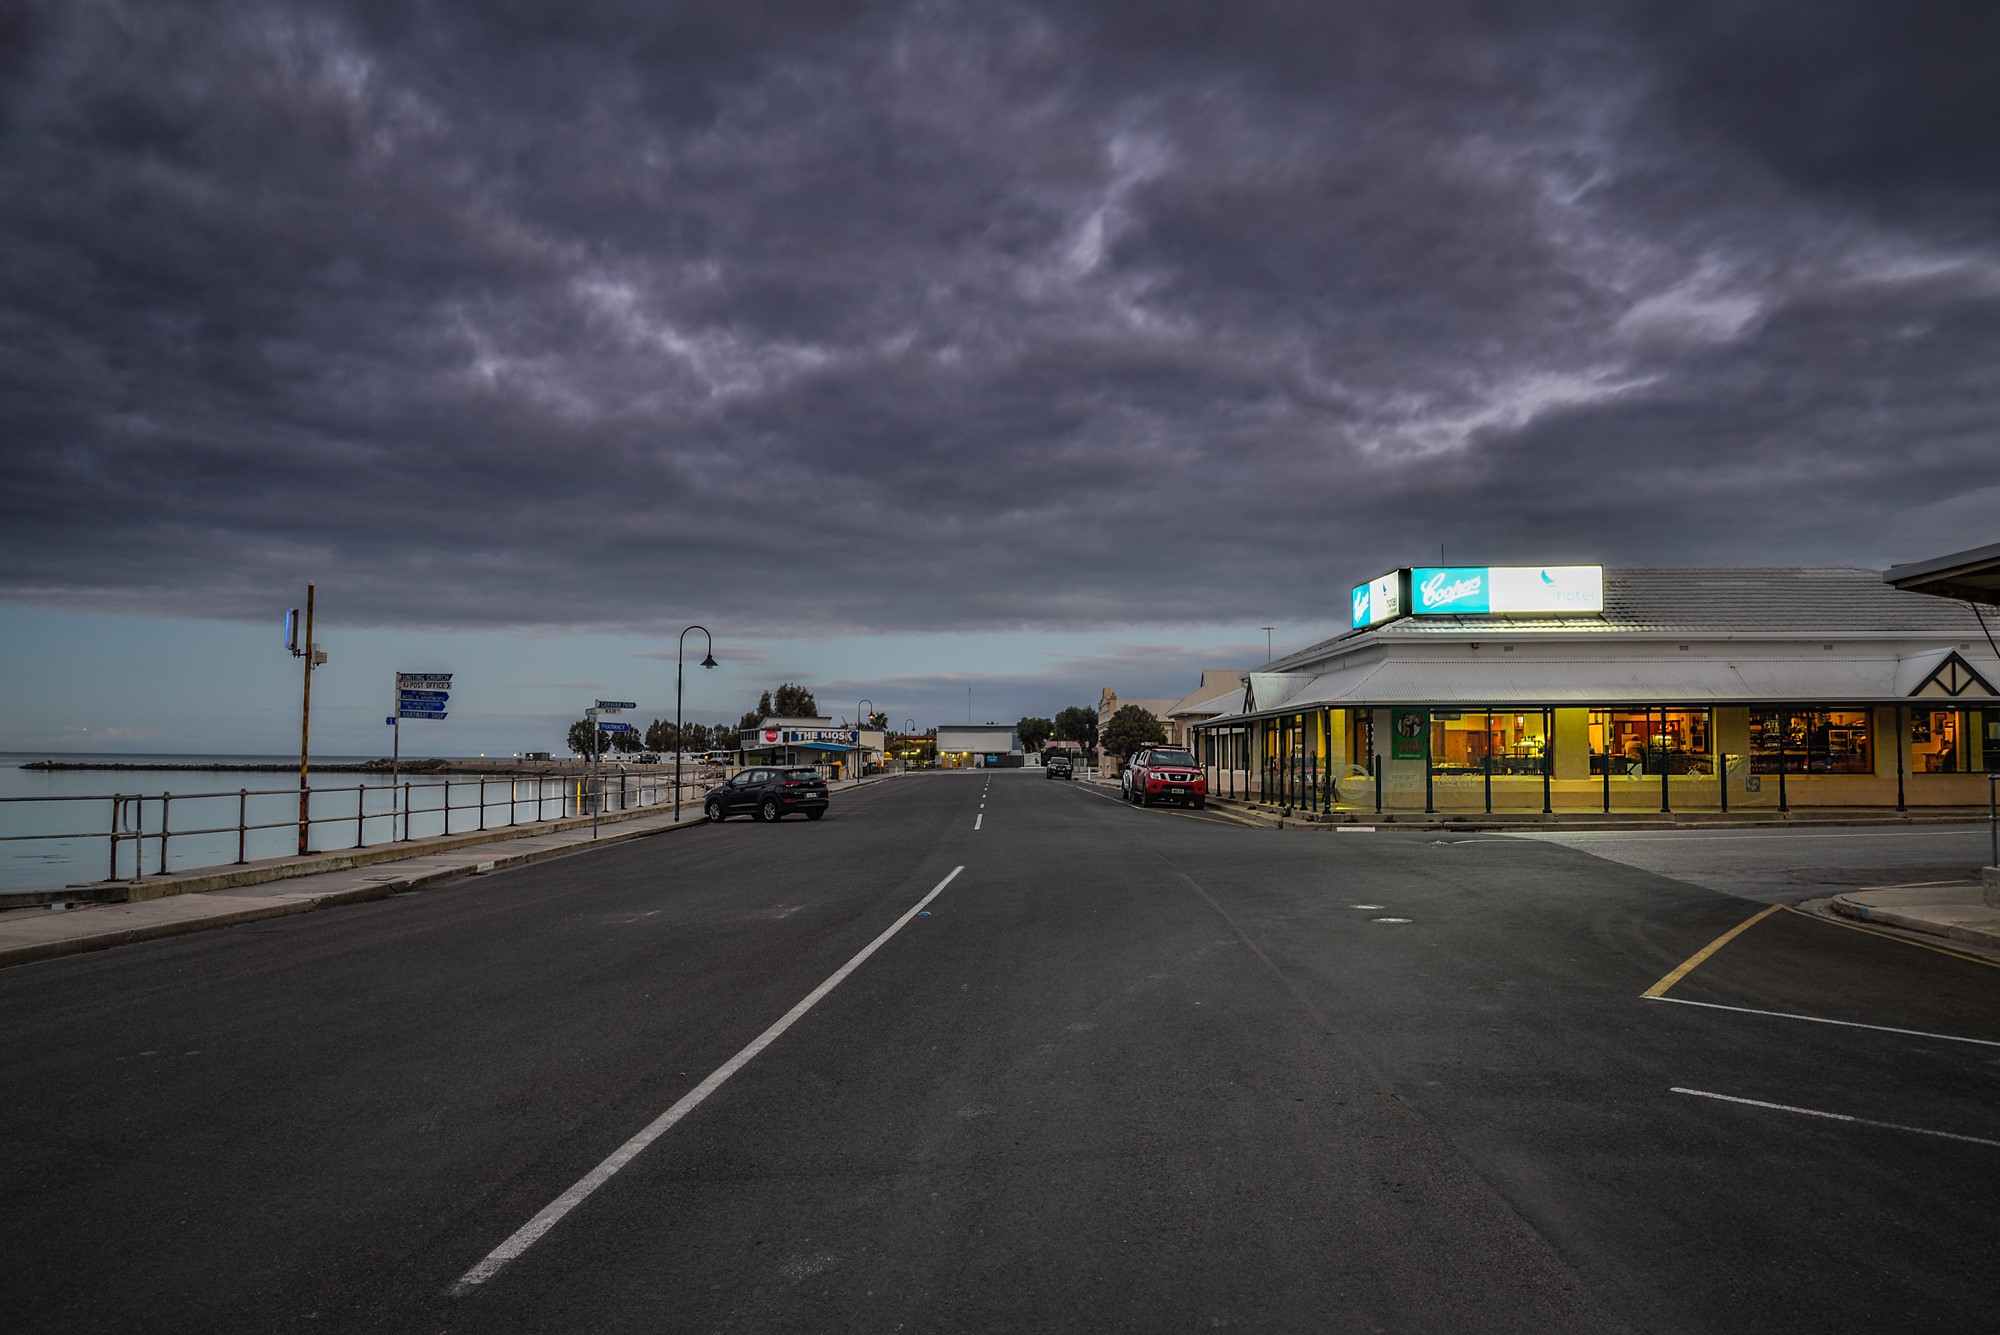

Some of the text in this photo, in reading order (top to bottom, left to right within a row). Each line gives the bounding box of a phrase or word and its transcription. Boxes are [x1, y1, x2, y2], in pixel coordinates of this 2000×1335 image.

[1420, 572, 1481, 609] Coopers
[1557, 590, 1595, 601] hotel
[796, 731, 853, 741] THE KIOSK
